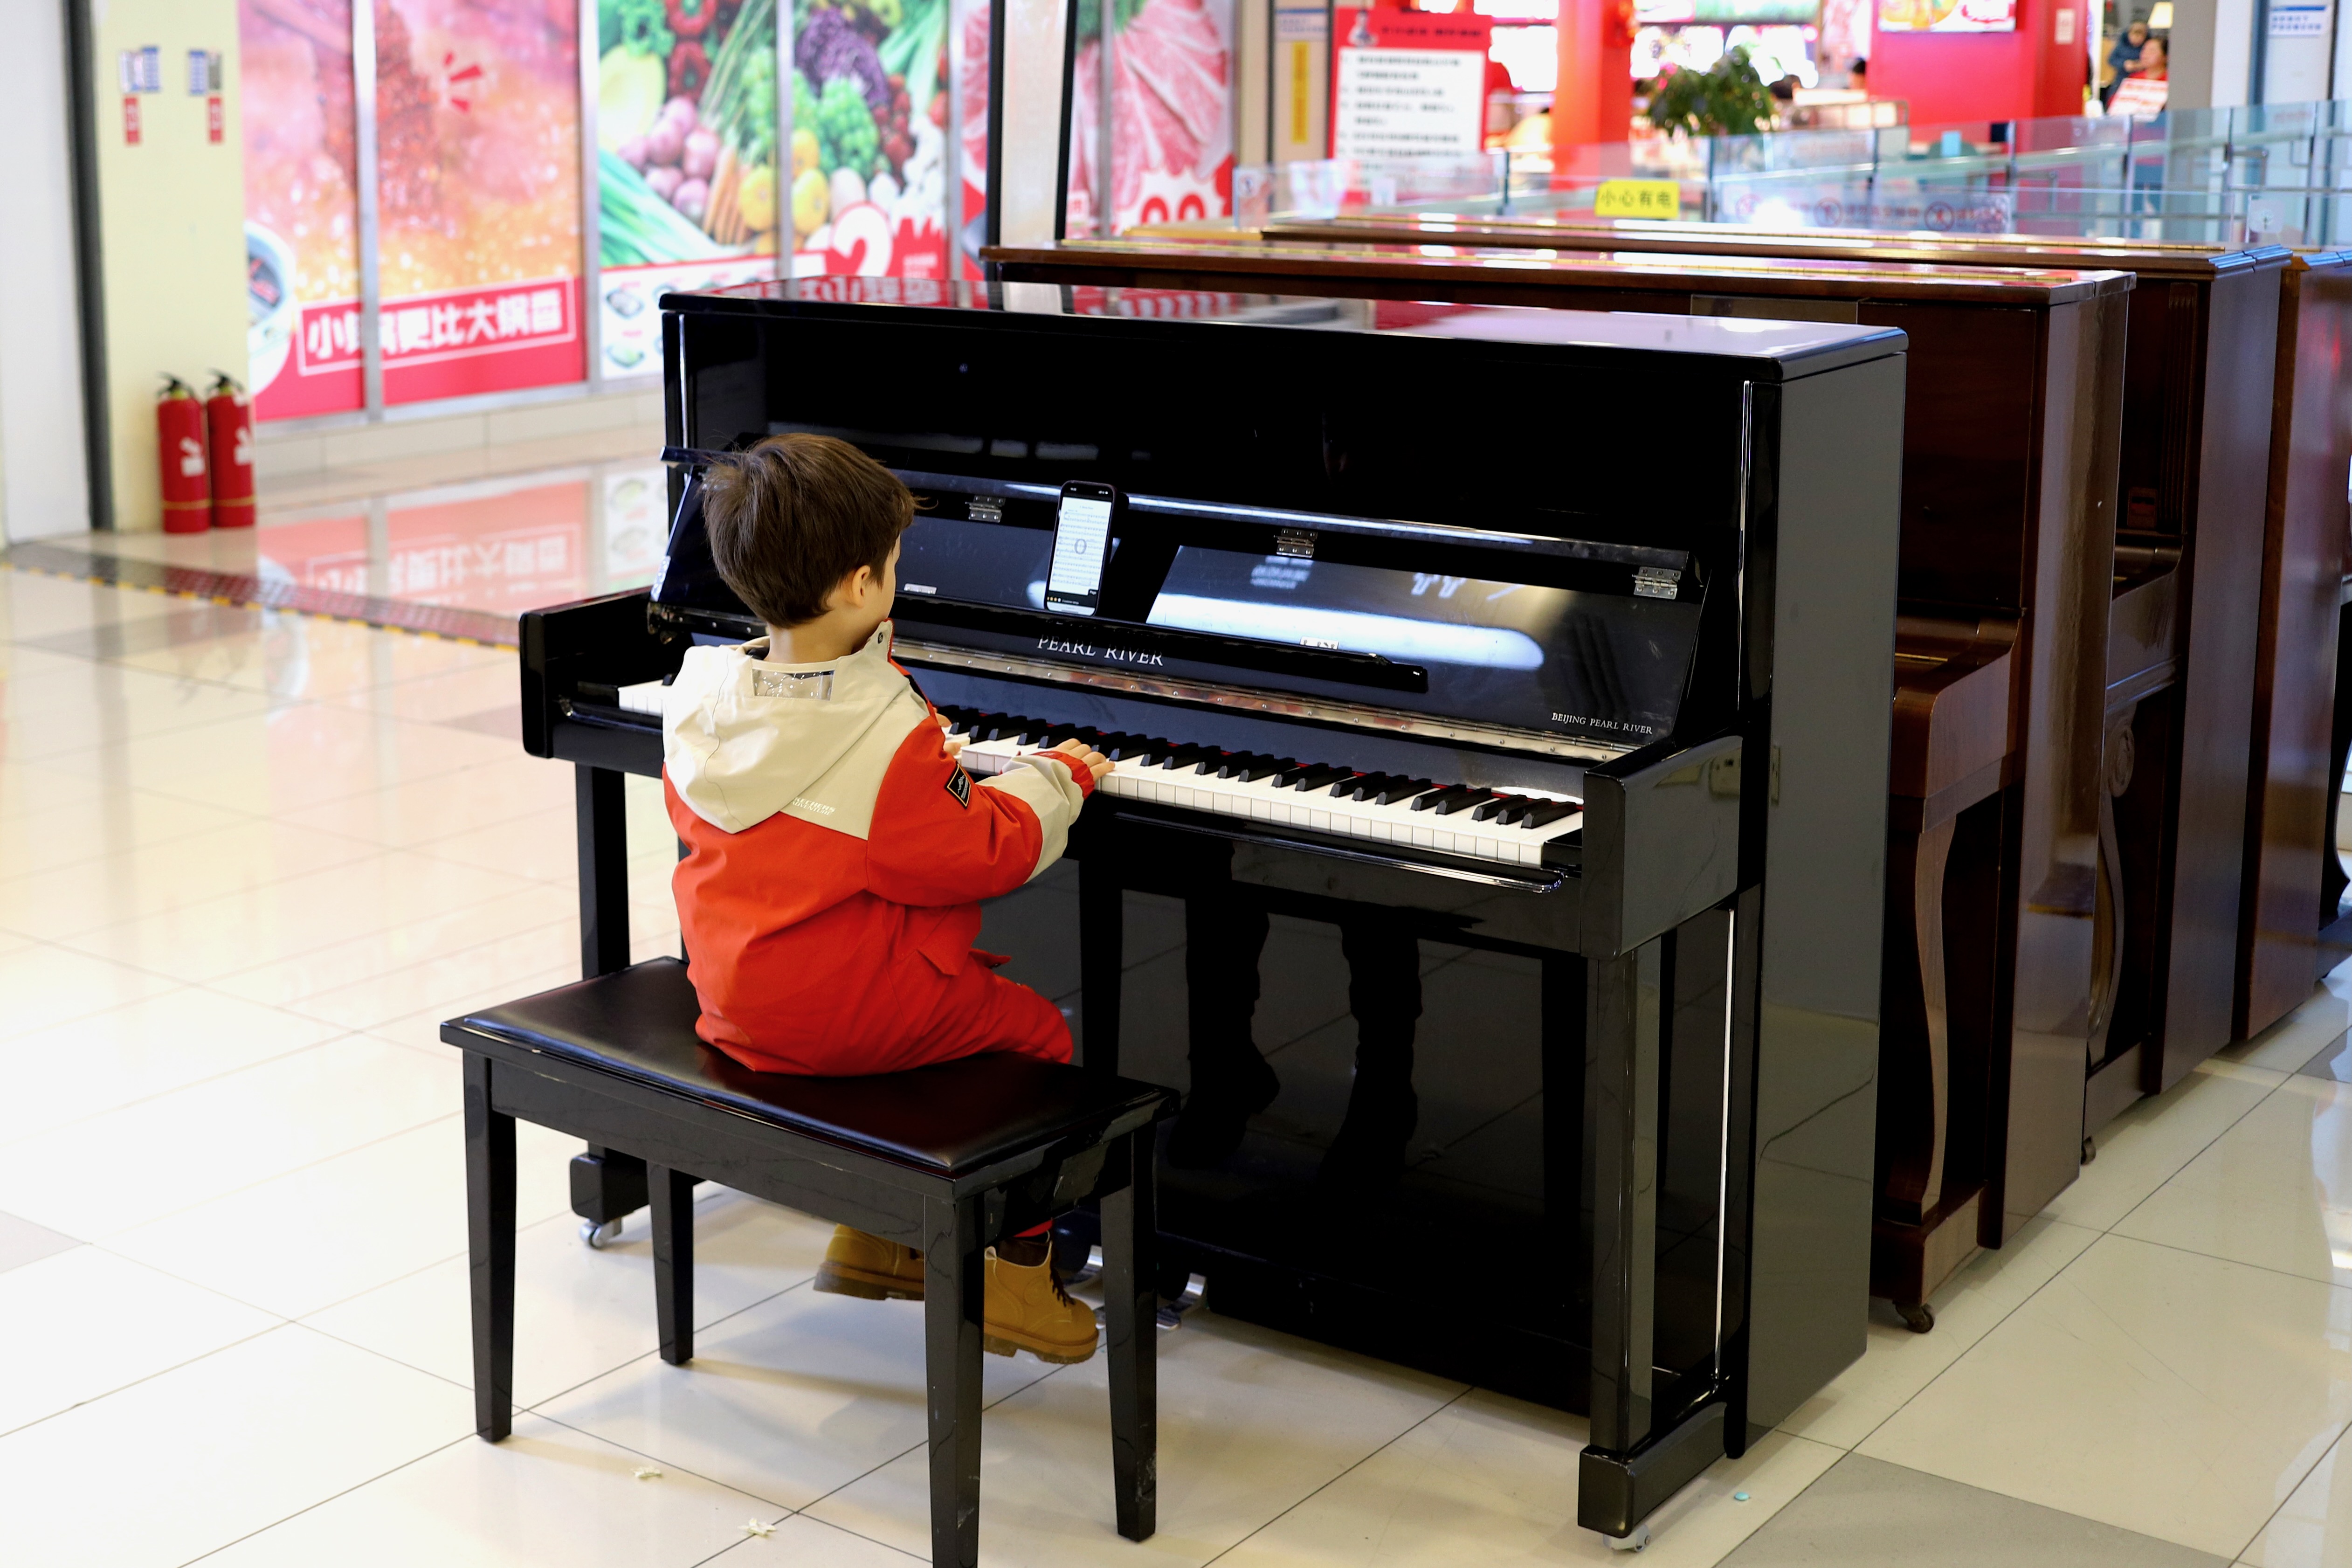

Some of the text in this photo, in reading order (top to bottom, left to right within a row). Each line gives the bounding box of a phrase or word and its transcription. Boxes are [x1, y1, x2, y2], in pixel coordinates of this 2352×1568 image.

[1600, 188, 1672, 209] 小心有电
[1037, 634, 1164, 666] PEARL RIVER
[1552, 712, 1653, 735] BEIJING PEARL RIVER
[794, 797, 836, 812] KECHERS
